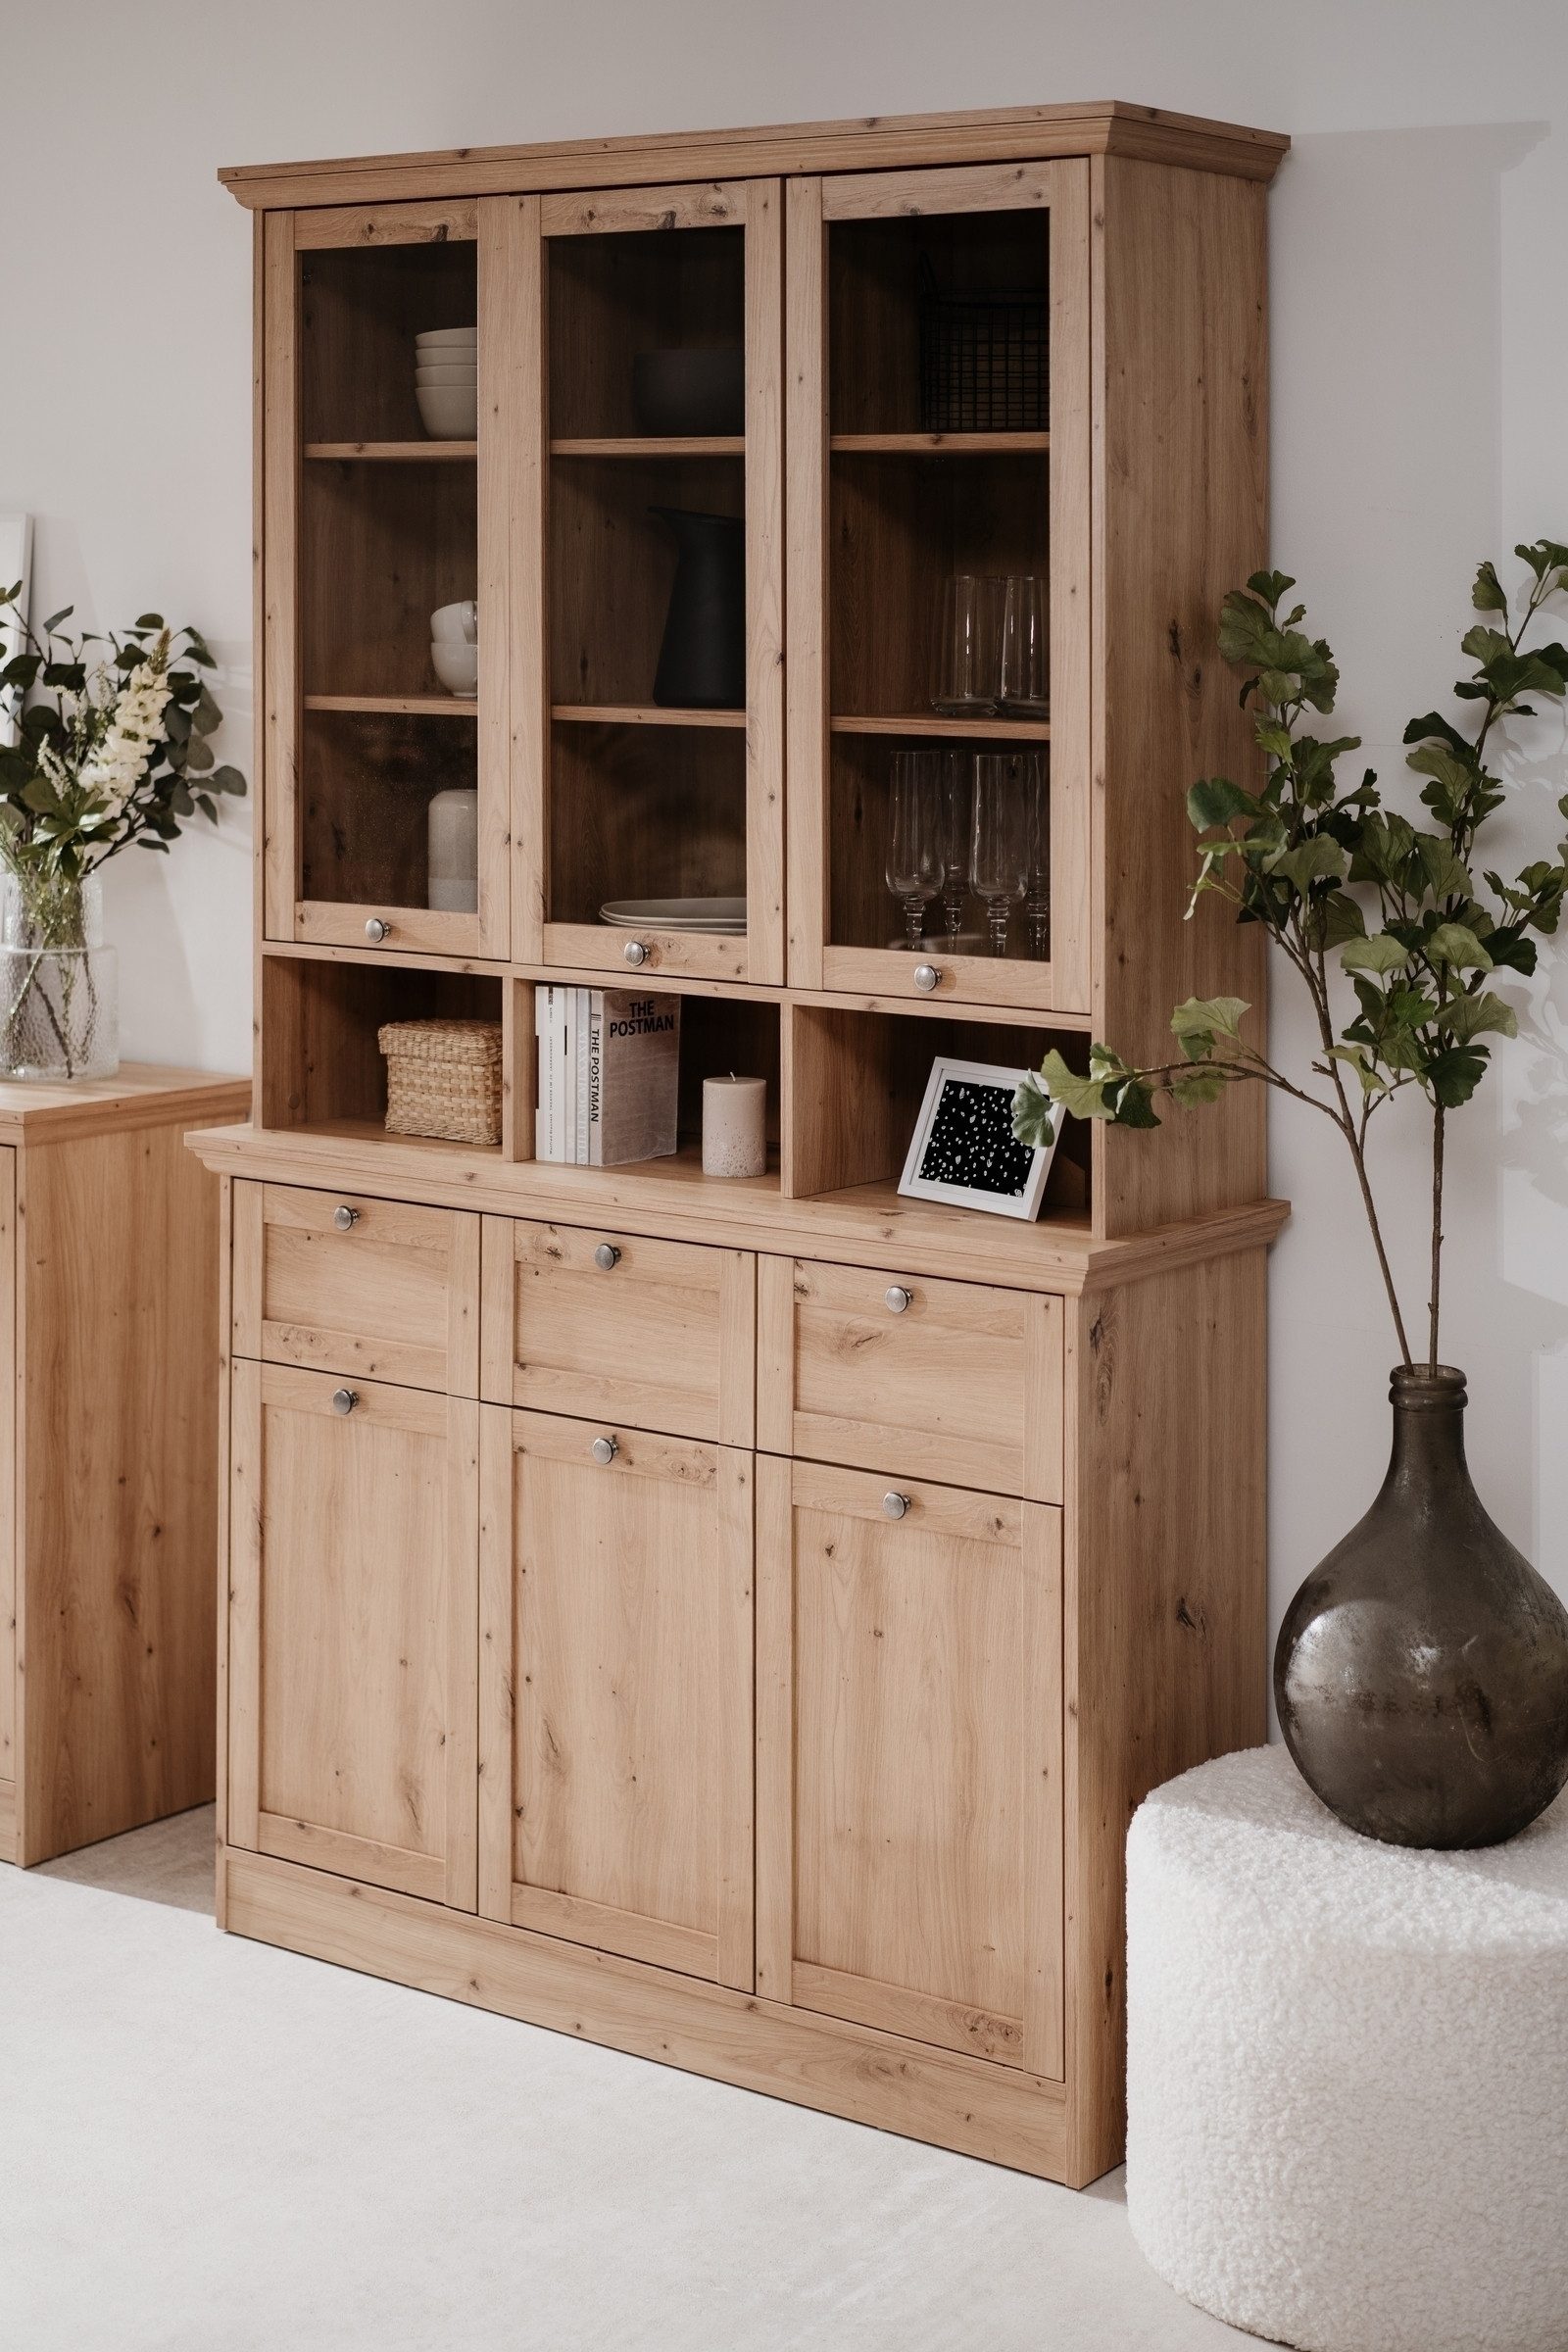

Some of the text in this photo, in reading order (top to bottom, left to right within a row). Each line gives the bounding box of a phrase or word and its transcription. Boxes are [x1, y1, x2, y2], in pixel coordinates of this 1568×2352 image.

[629, 1001, 655, 1018] THE
[610, 1014, 674, 1038] POSTMAN
[591, 1029, 600, 1122] THE POSTMAN
